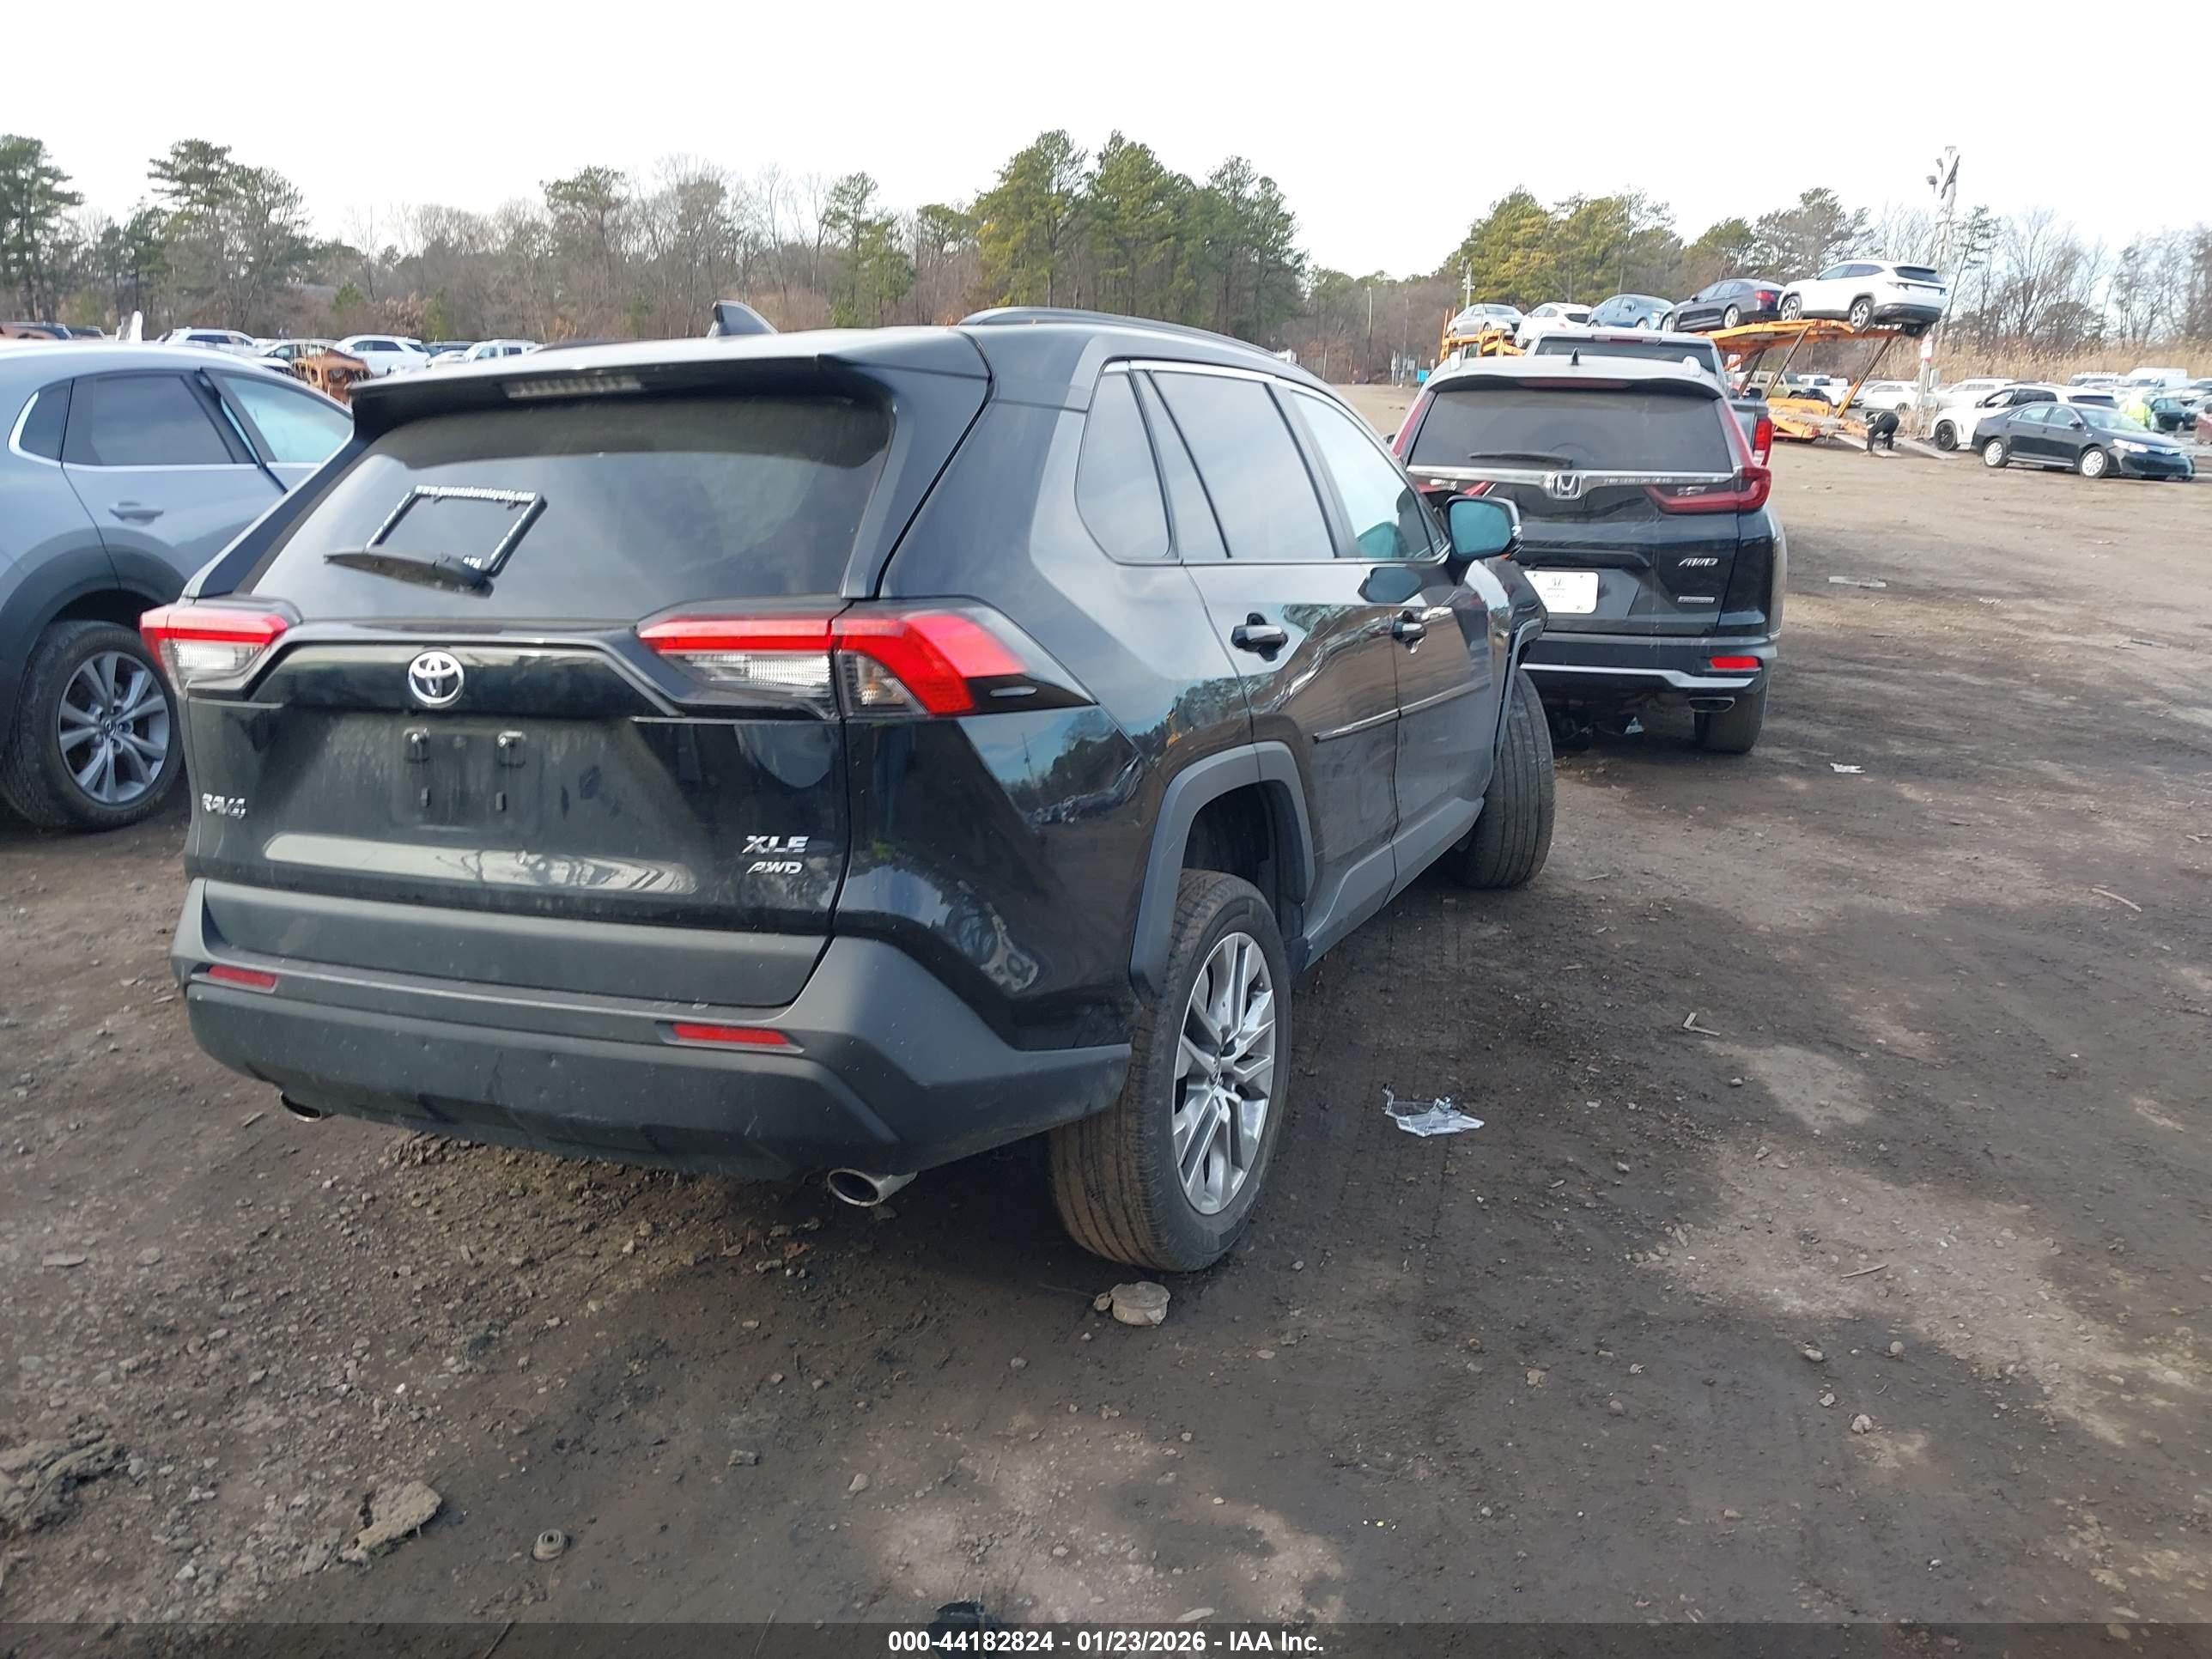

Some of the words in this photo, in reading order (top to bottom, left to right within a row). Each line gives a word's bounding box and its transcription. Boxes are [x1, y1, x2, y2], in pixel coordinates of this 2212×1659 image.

[1678, 557, 1718, 567] AWD
[202, 793, 246, 819] RAV4
[742, 836, 810, 853] XLE
[745, 861, 803, 874] AWD
